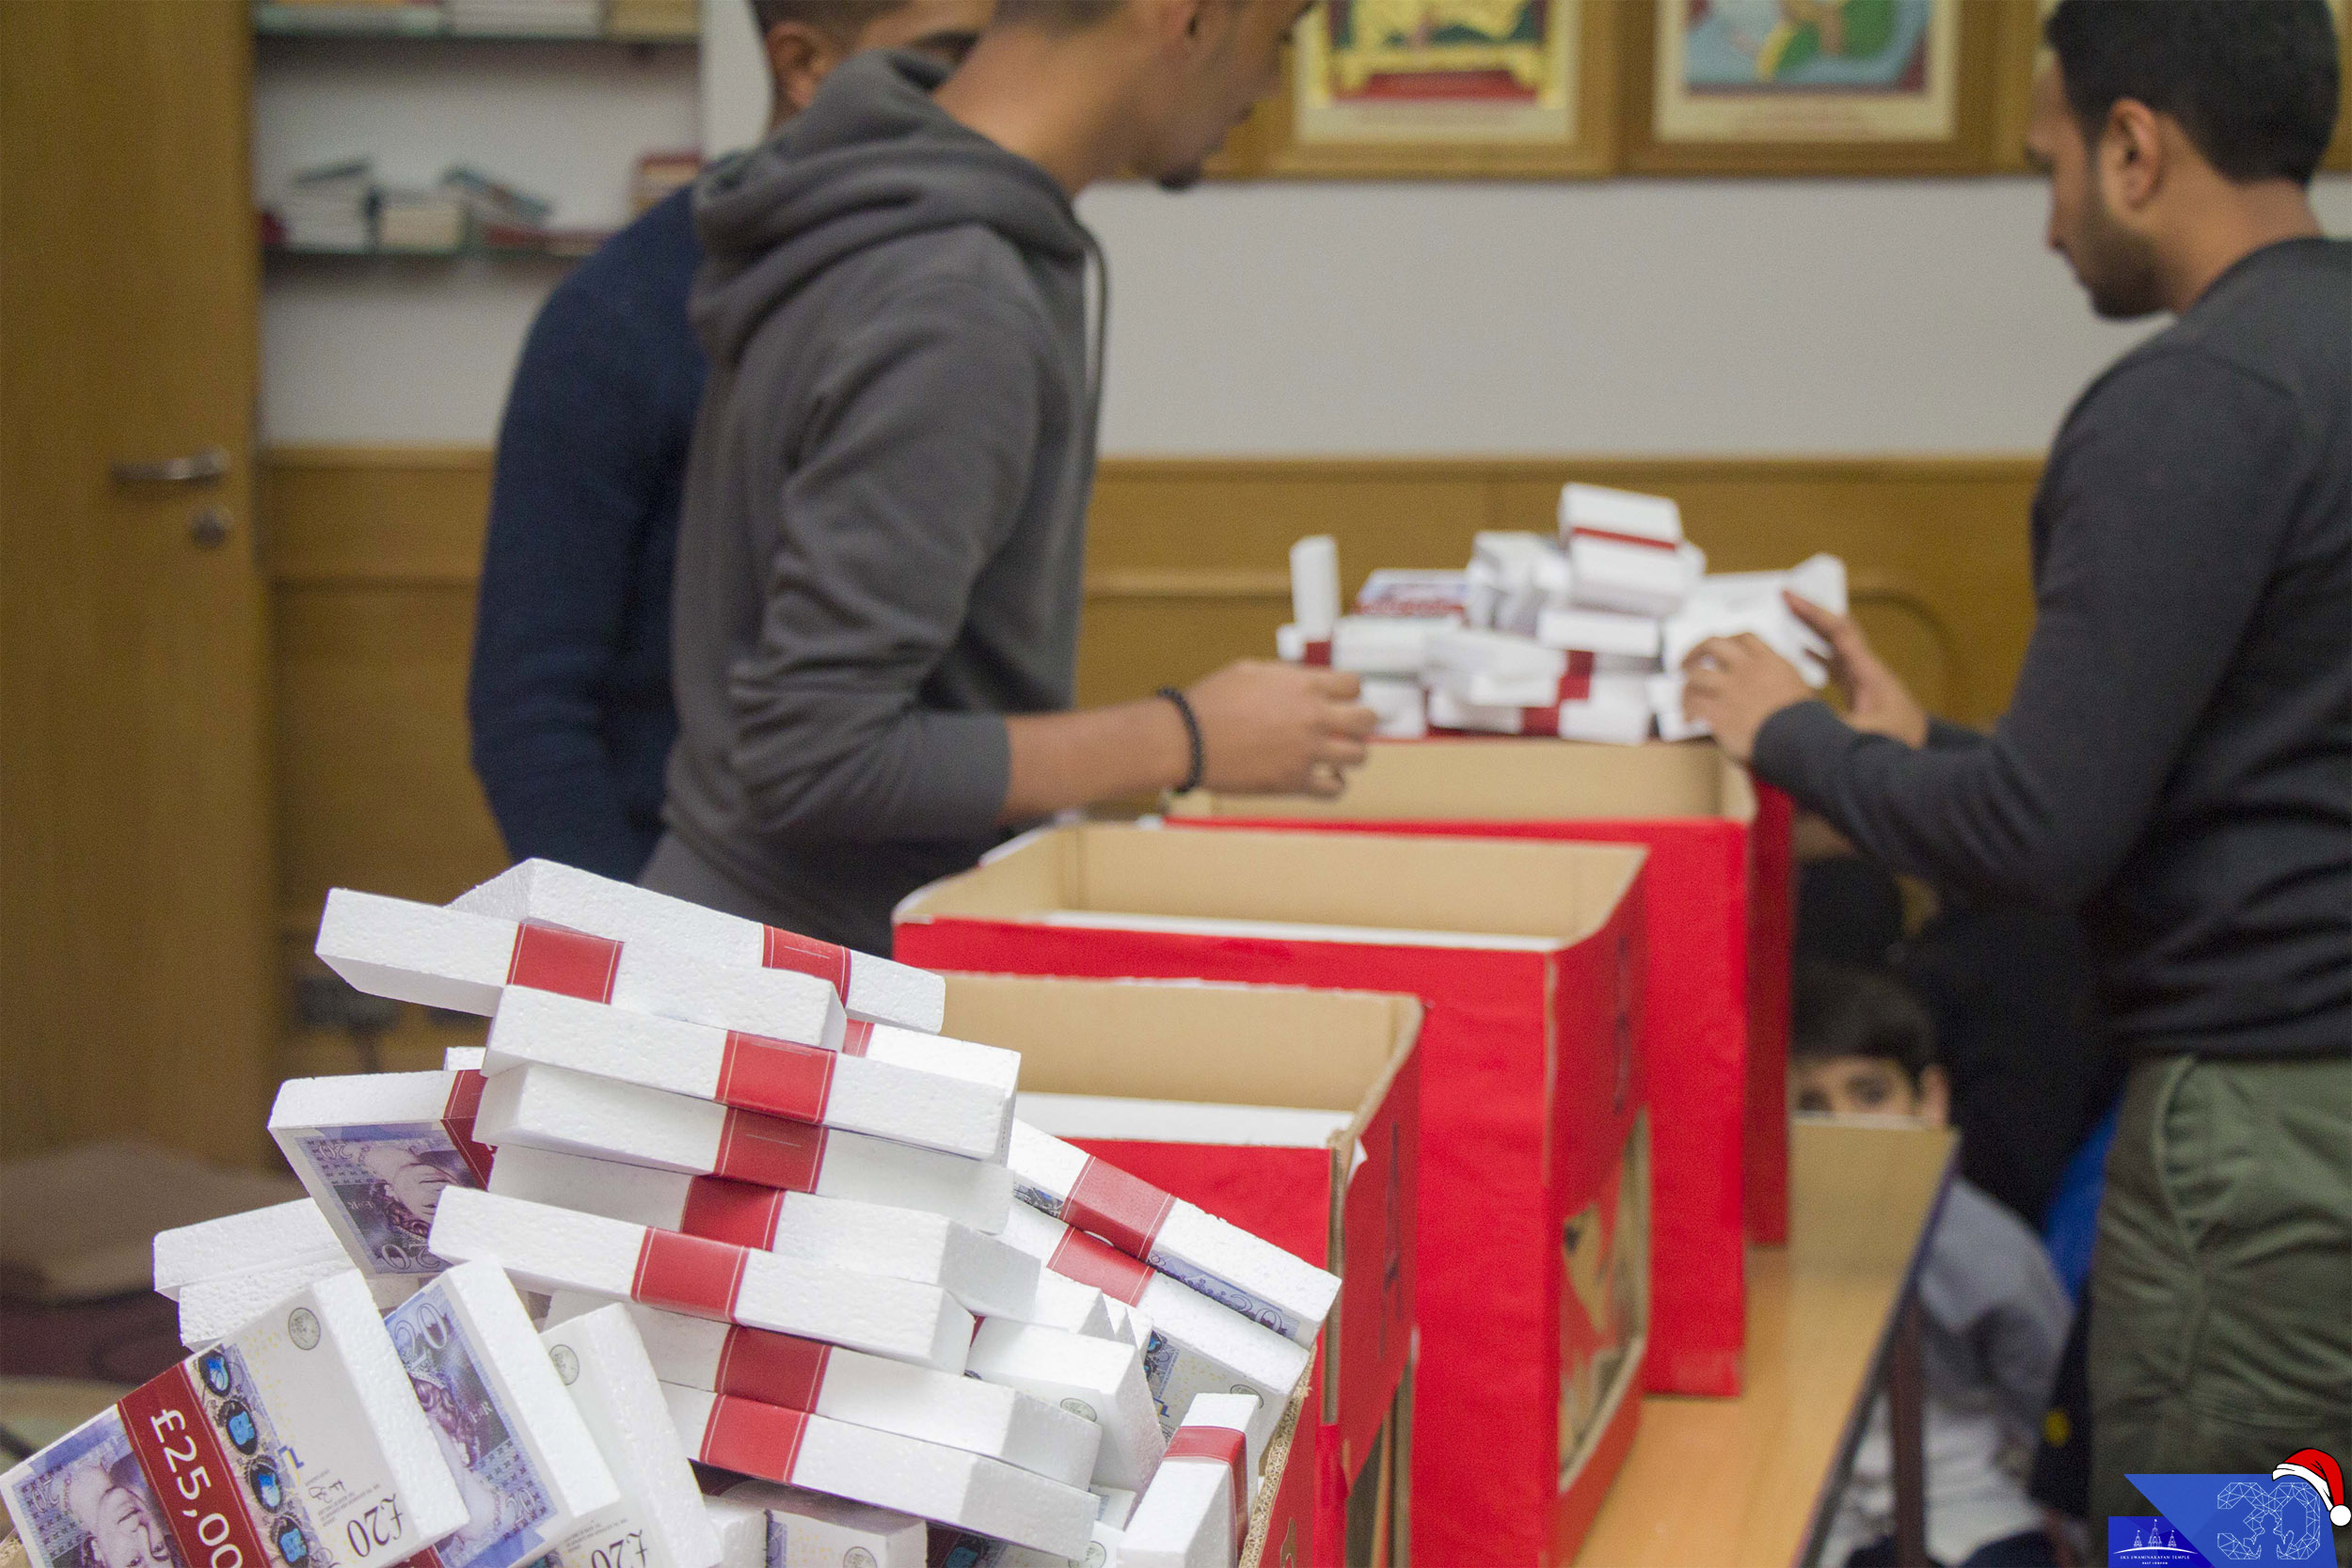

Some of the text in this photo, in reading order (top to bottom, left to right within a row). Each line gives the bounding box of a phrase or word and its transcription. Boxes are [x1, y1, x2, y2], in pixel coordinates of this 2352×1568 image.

[318, 1141, 354, 1161] 20
[393, 1303, 448, 1370] 20
[32, 1477, 60, 1513] 20
[505, 1487, 536, 1524] 20
[346, 1493, 404, 1558] £20
